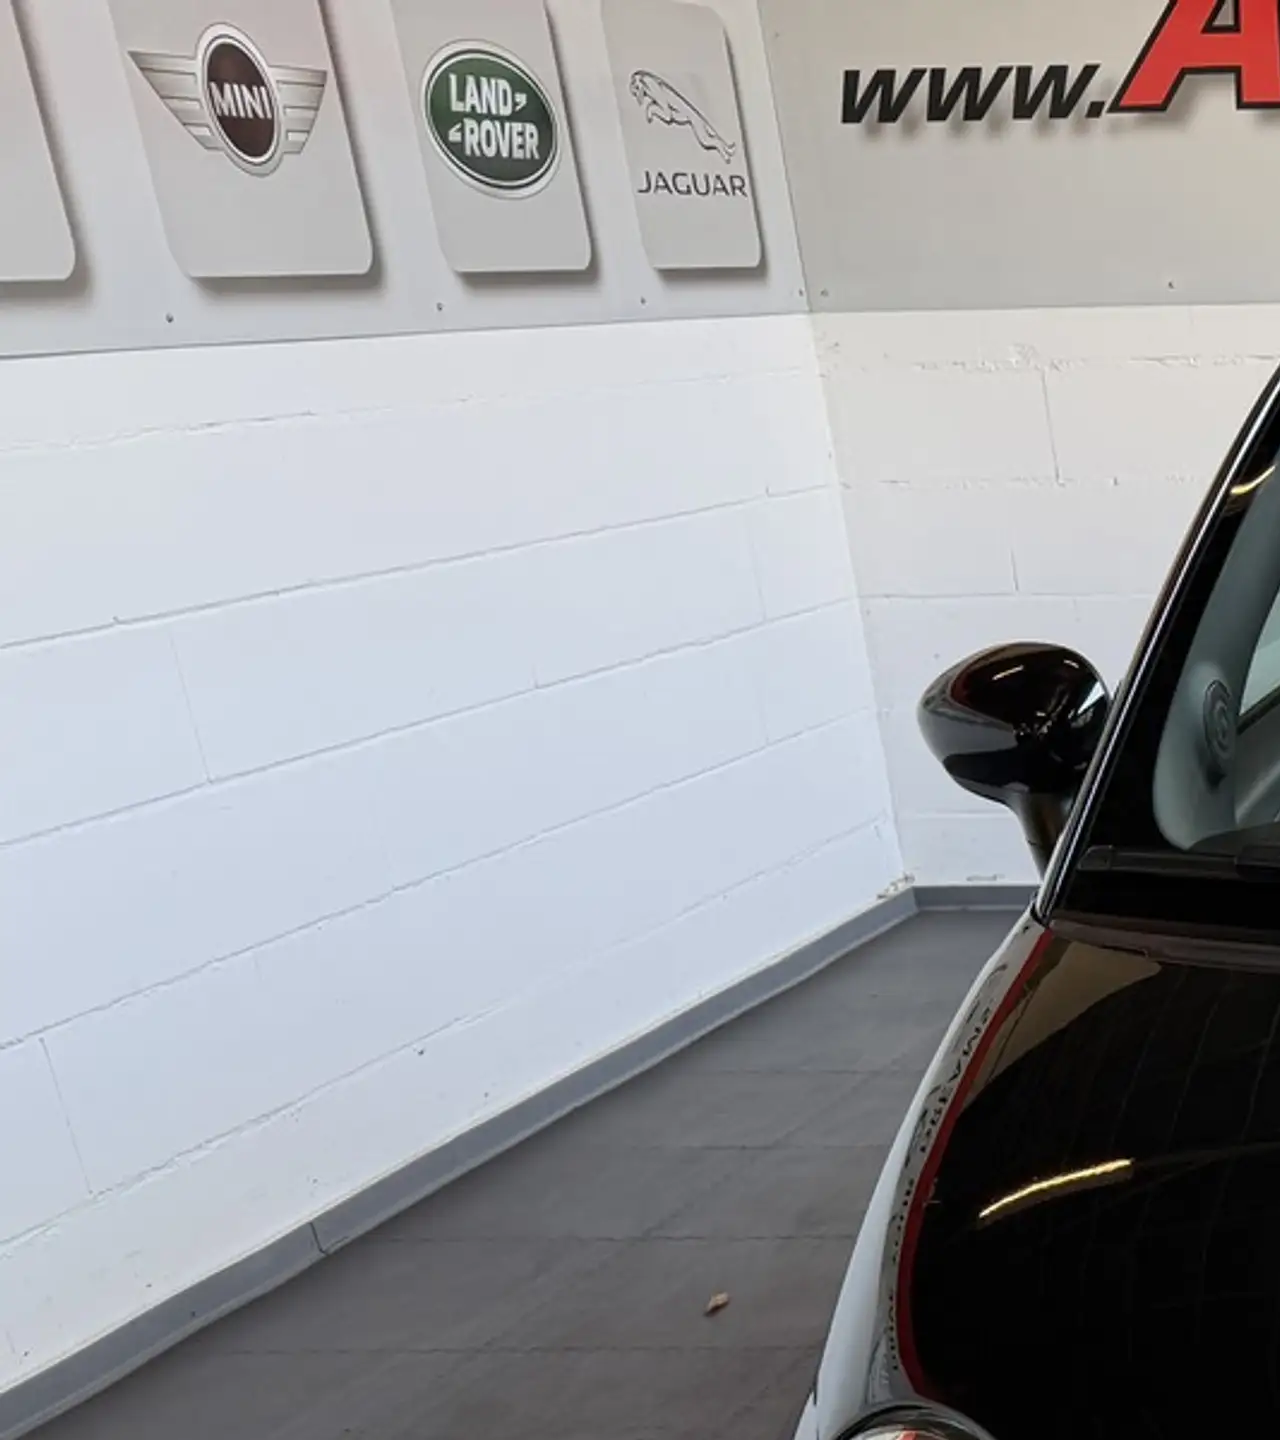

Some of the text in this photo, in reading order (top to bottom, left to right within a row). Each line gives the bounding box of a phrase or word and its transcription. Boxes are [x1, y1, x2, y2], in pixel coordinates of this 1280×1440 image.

[213, 79, 272, 120] MINI
[448, 73, 513, 115] LAND
[463, 121, 541, 162] ROVER
[636, 169, 749, 198] JAGUAR
